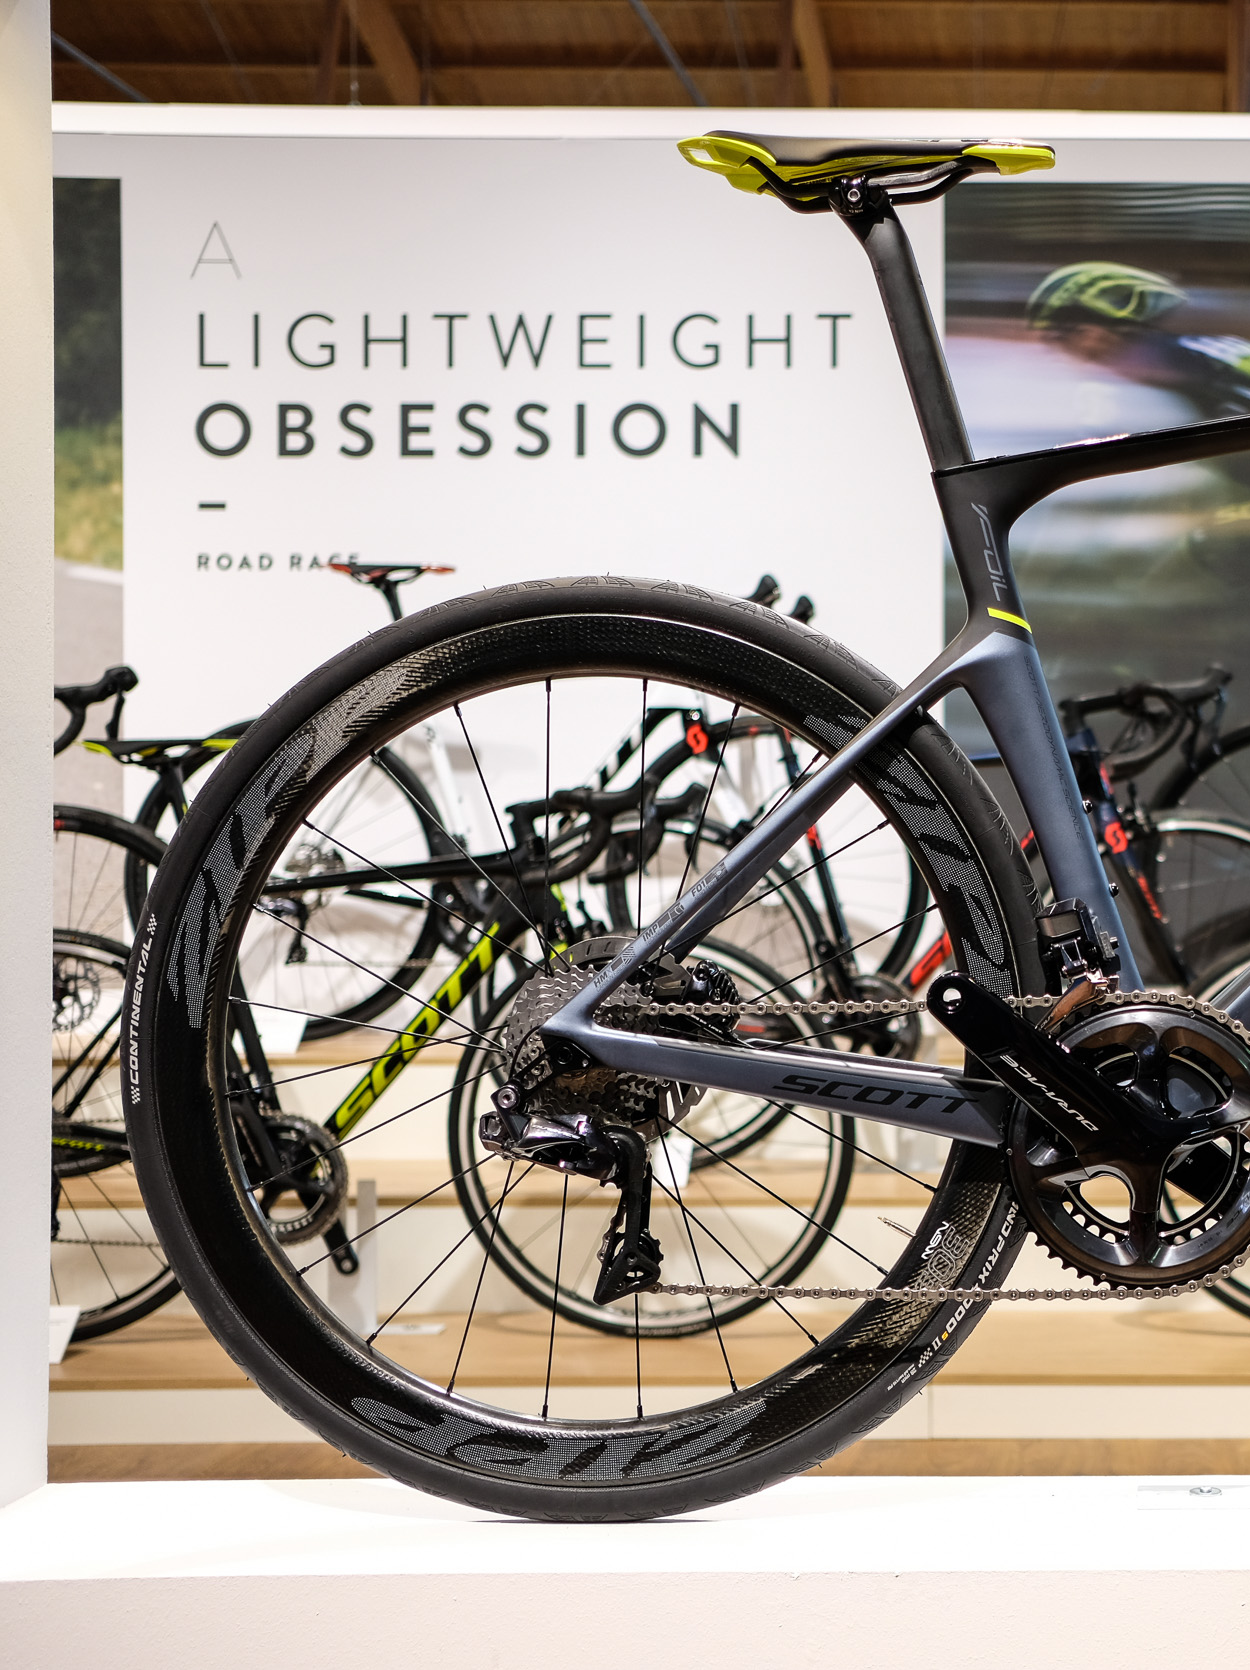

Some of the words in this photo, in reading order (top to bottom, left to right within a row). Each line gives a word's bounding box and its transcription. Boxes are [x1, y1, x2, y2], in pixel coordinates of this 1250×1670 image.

[191, 219, 242, 281] A
[197, 312, 854, 369] LIGHTWEIGHT
[194, 402, 741, 458] OBSESSION
[197, 553, 274, 571] ROAD
[128, 937, 153, 1086] CONTINENTAL
[335, 920, 500, 1143] SCOTT
[772, 1074, 980, 1114] SCOTT
[1000, 1054, 1100, 1132] DURA-ACE
[977, 1233, 1006, 1285] PRIX
[941, 1283, 979, 1341] 000S
[351, 1397, 767, 1480] ZIPP
